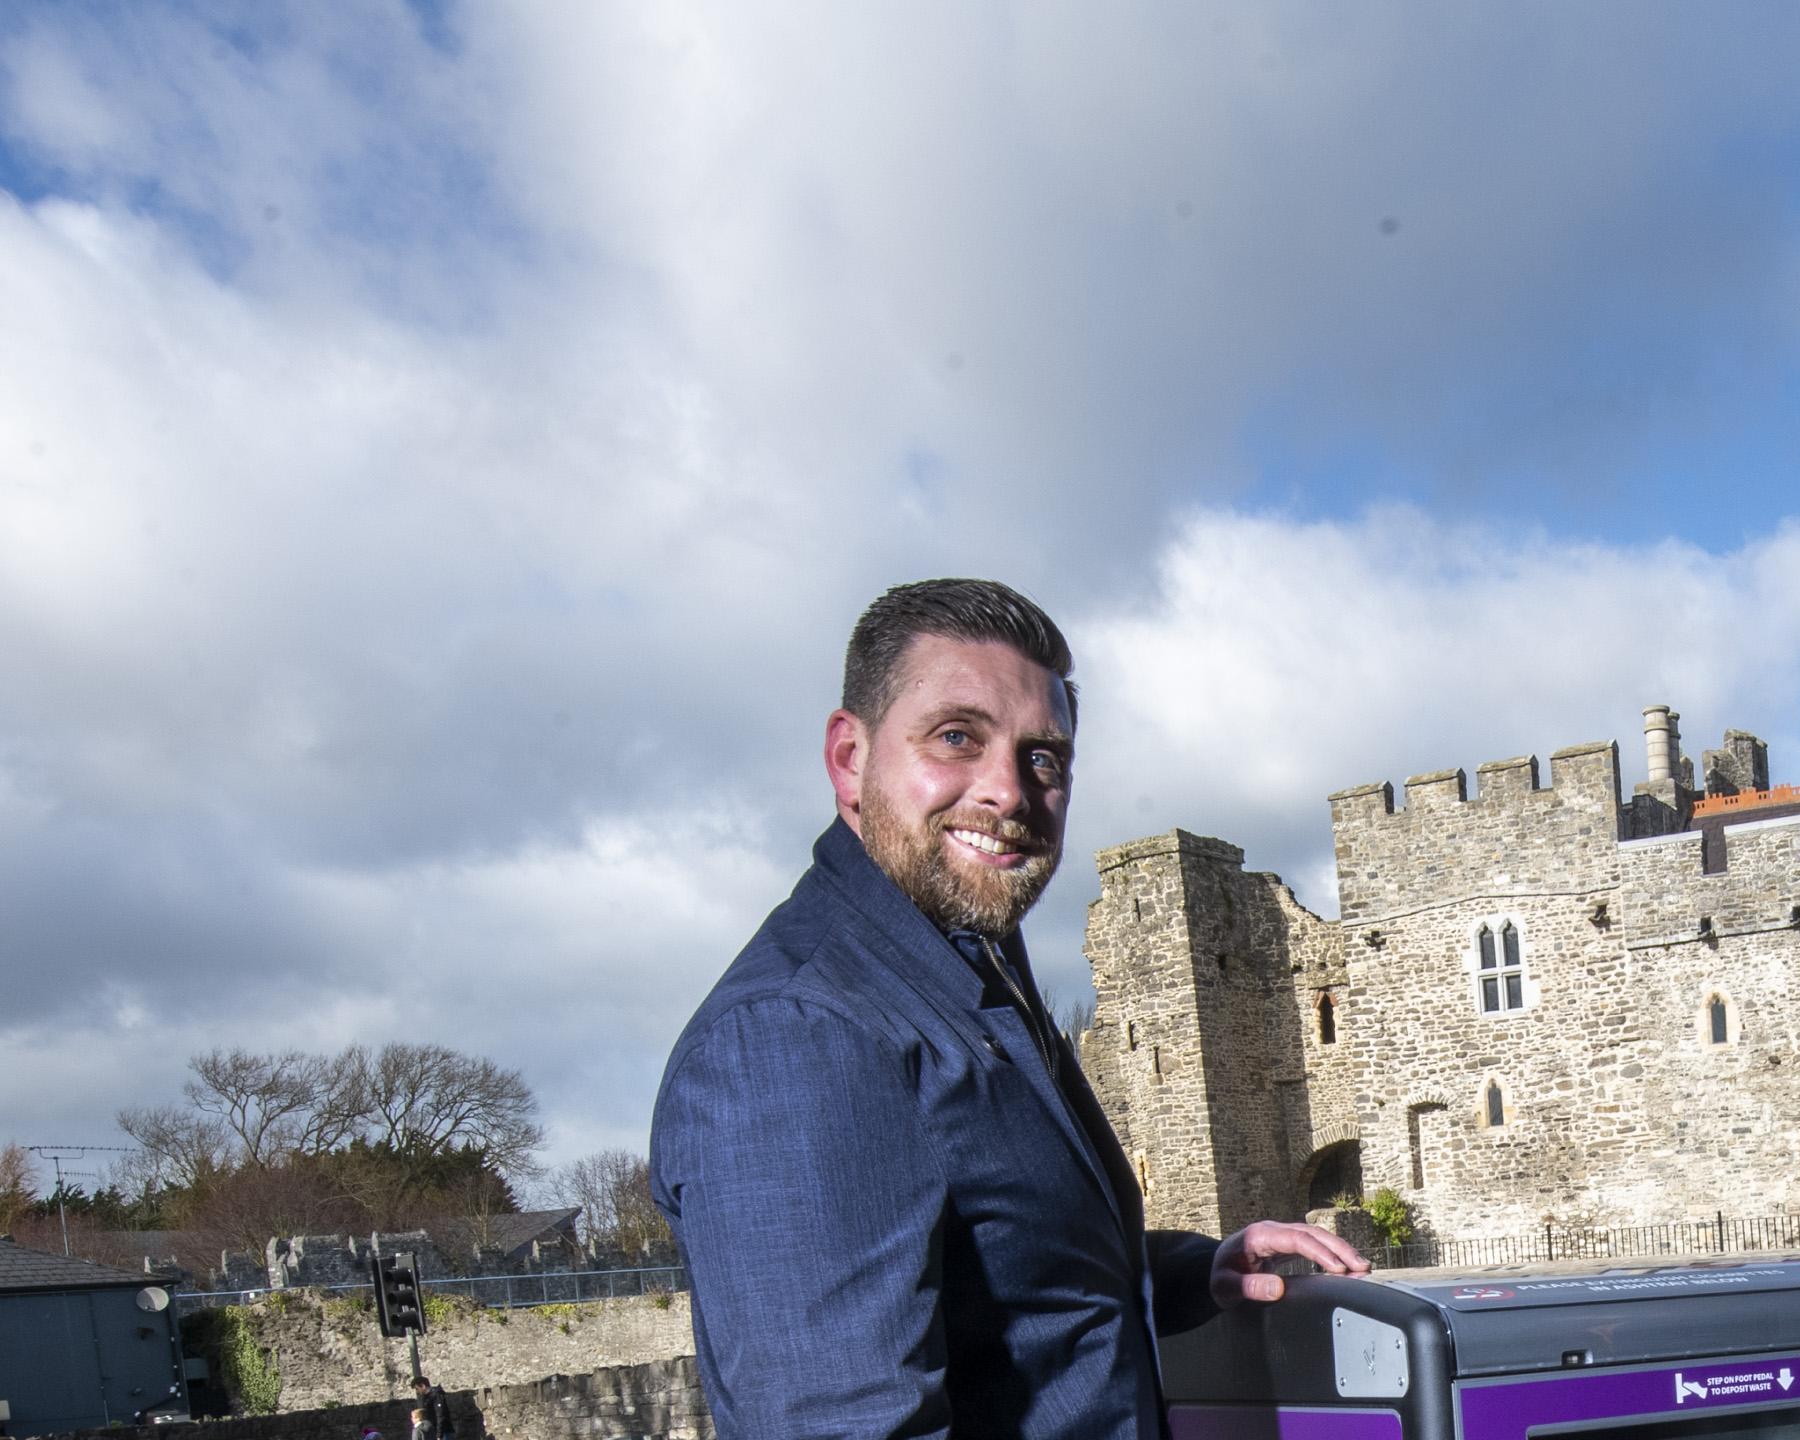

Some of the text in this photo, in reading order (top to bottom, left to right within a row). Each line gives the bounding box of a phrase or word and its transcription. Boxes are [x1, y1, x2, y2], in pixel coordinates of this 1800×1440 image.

[1516, 1281, 1583, 1290] PLEASE
[1707, 1372, 1774, 1386] STEP ON FOOT PEDAL
[1711, 1382, 1771, 1395] TO DEPOSIT WASTE
